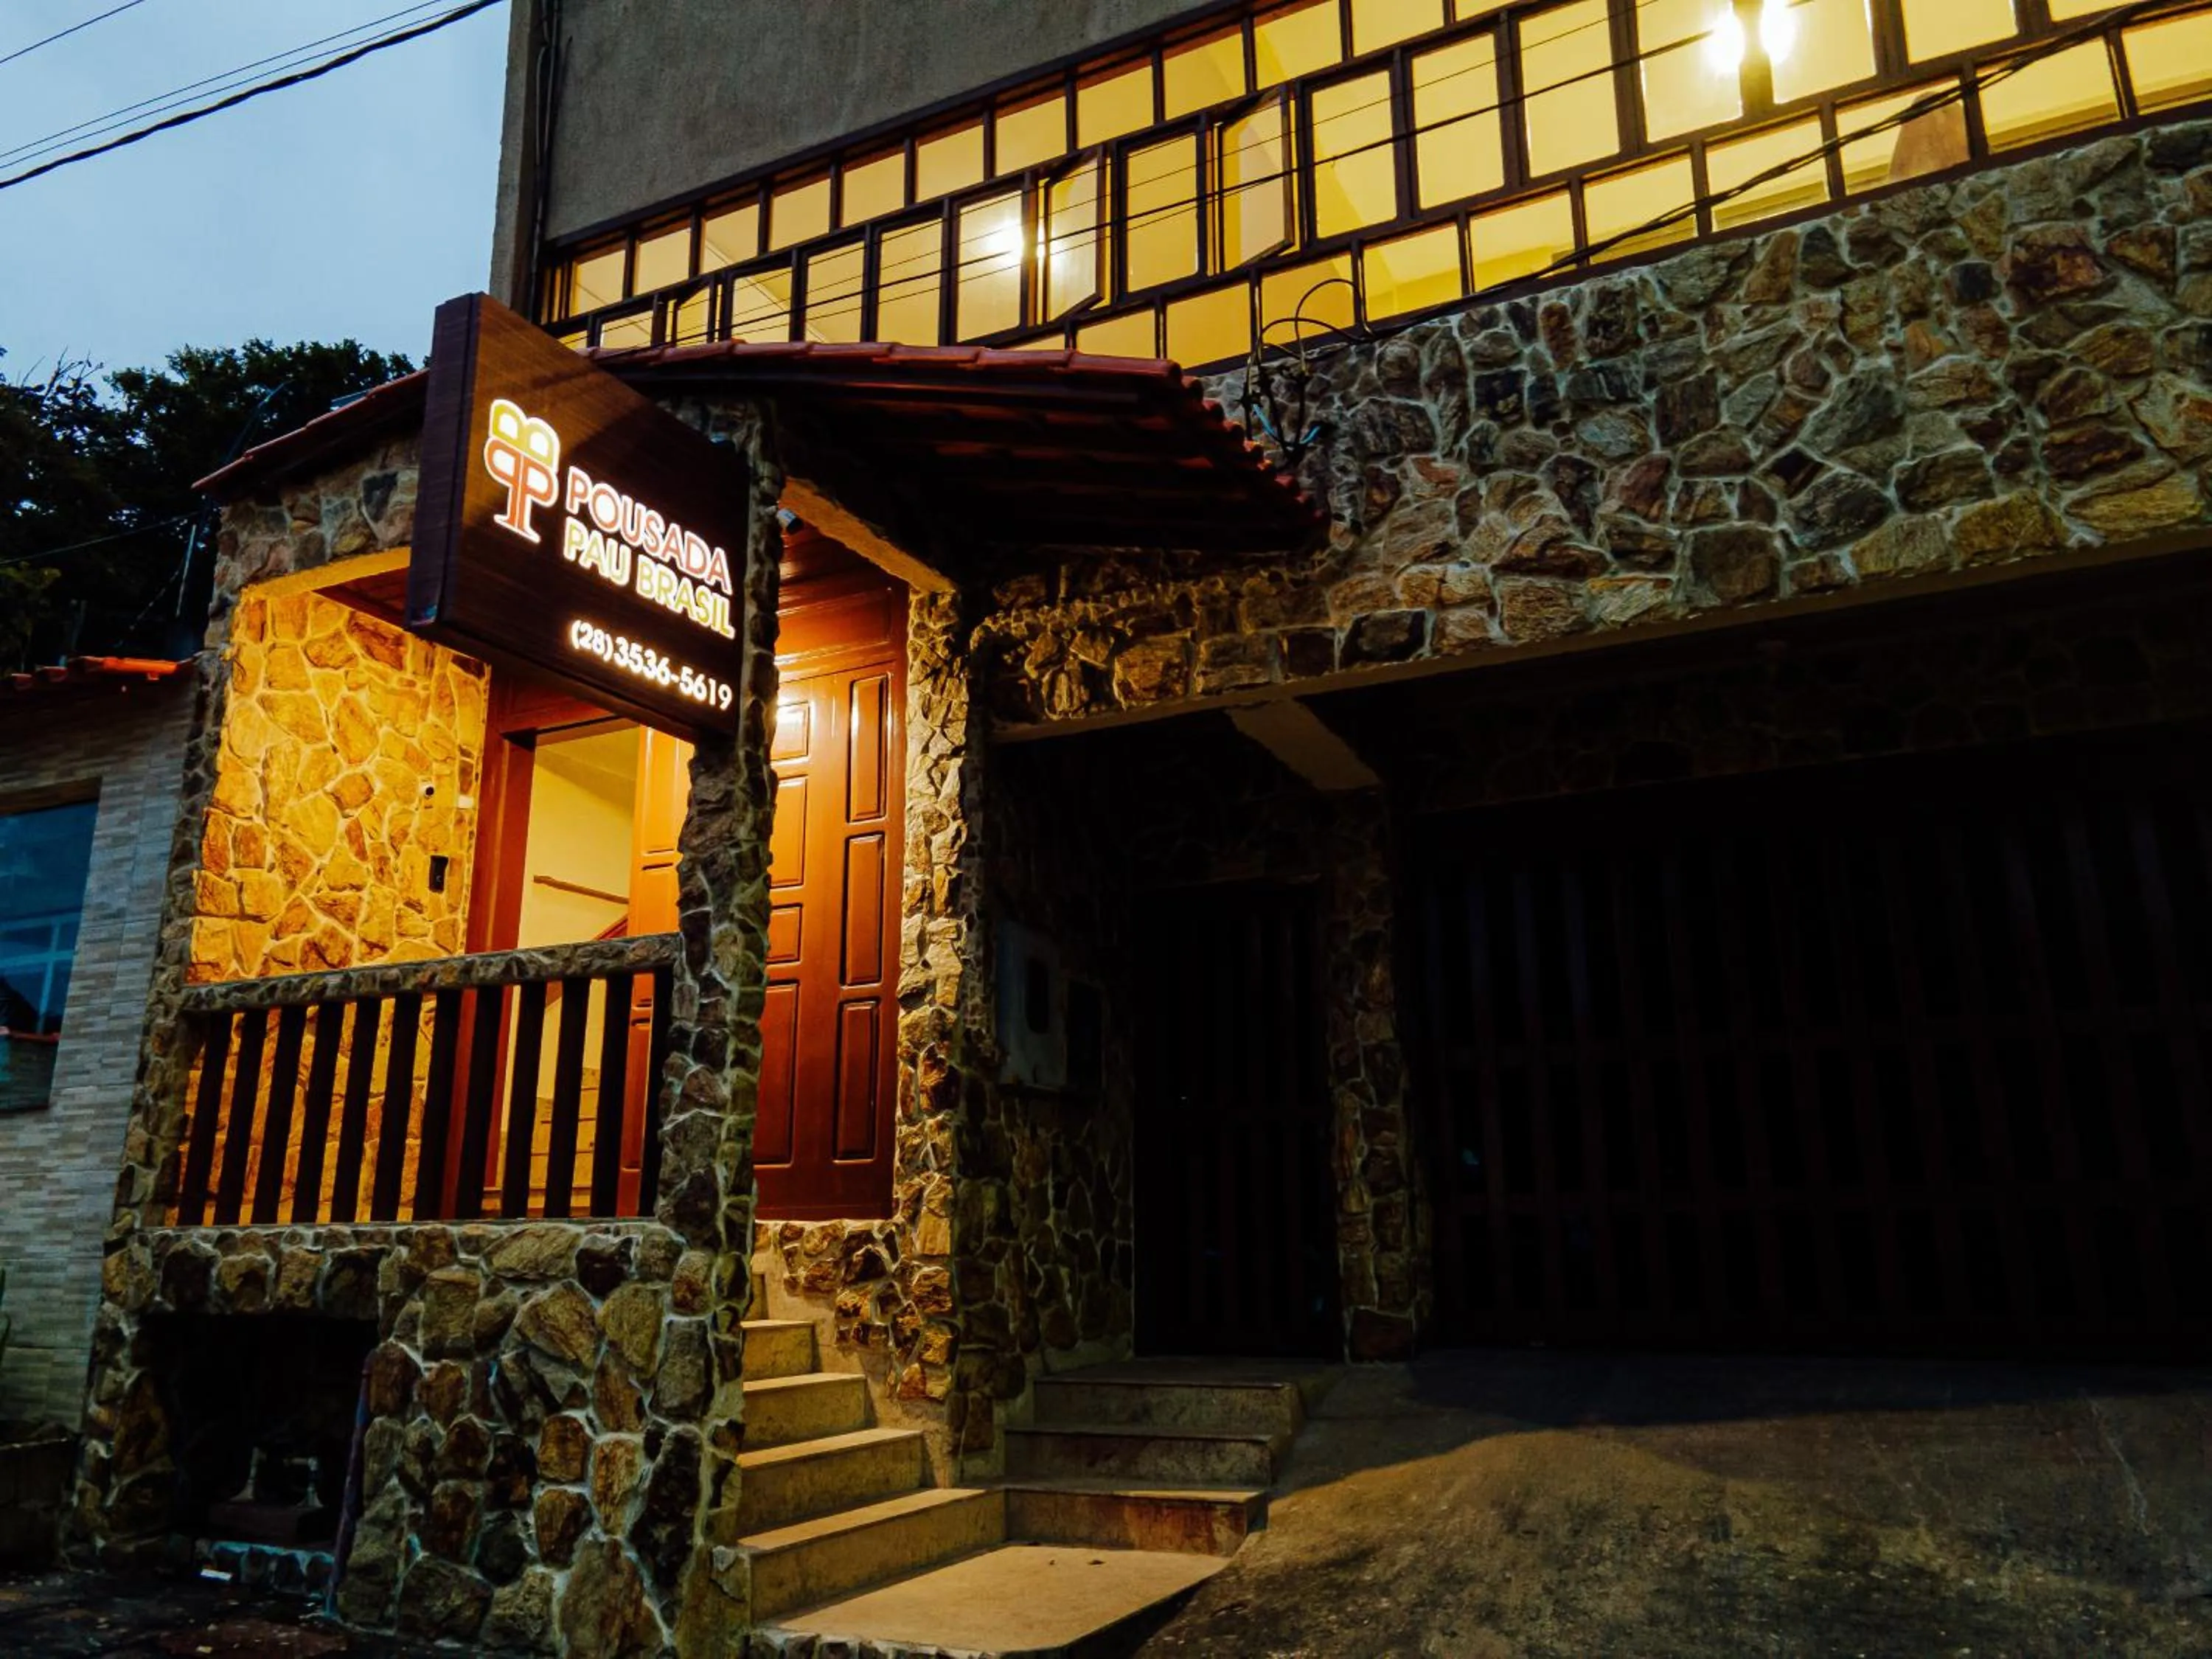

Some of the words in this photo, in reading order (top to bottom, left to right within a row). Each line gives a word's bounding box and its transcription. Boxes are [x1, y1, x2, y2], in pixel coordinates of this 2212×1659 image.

[563, 516, 631, 585] PAU
[636, 554, 735, 640] BRASIL
[566, 466, 733, 595] POUSADA
